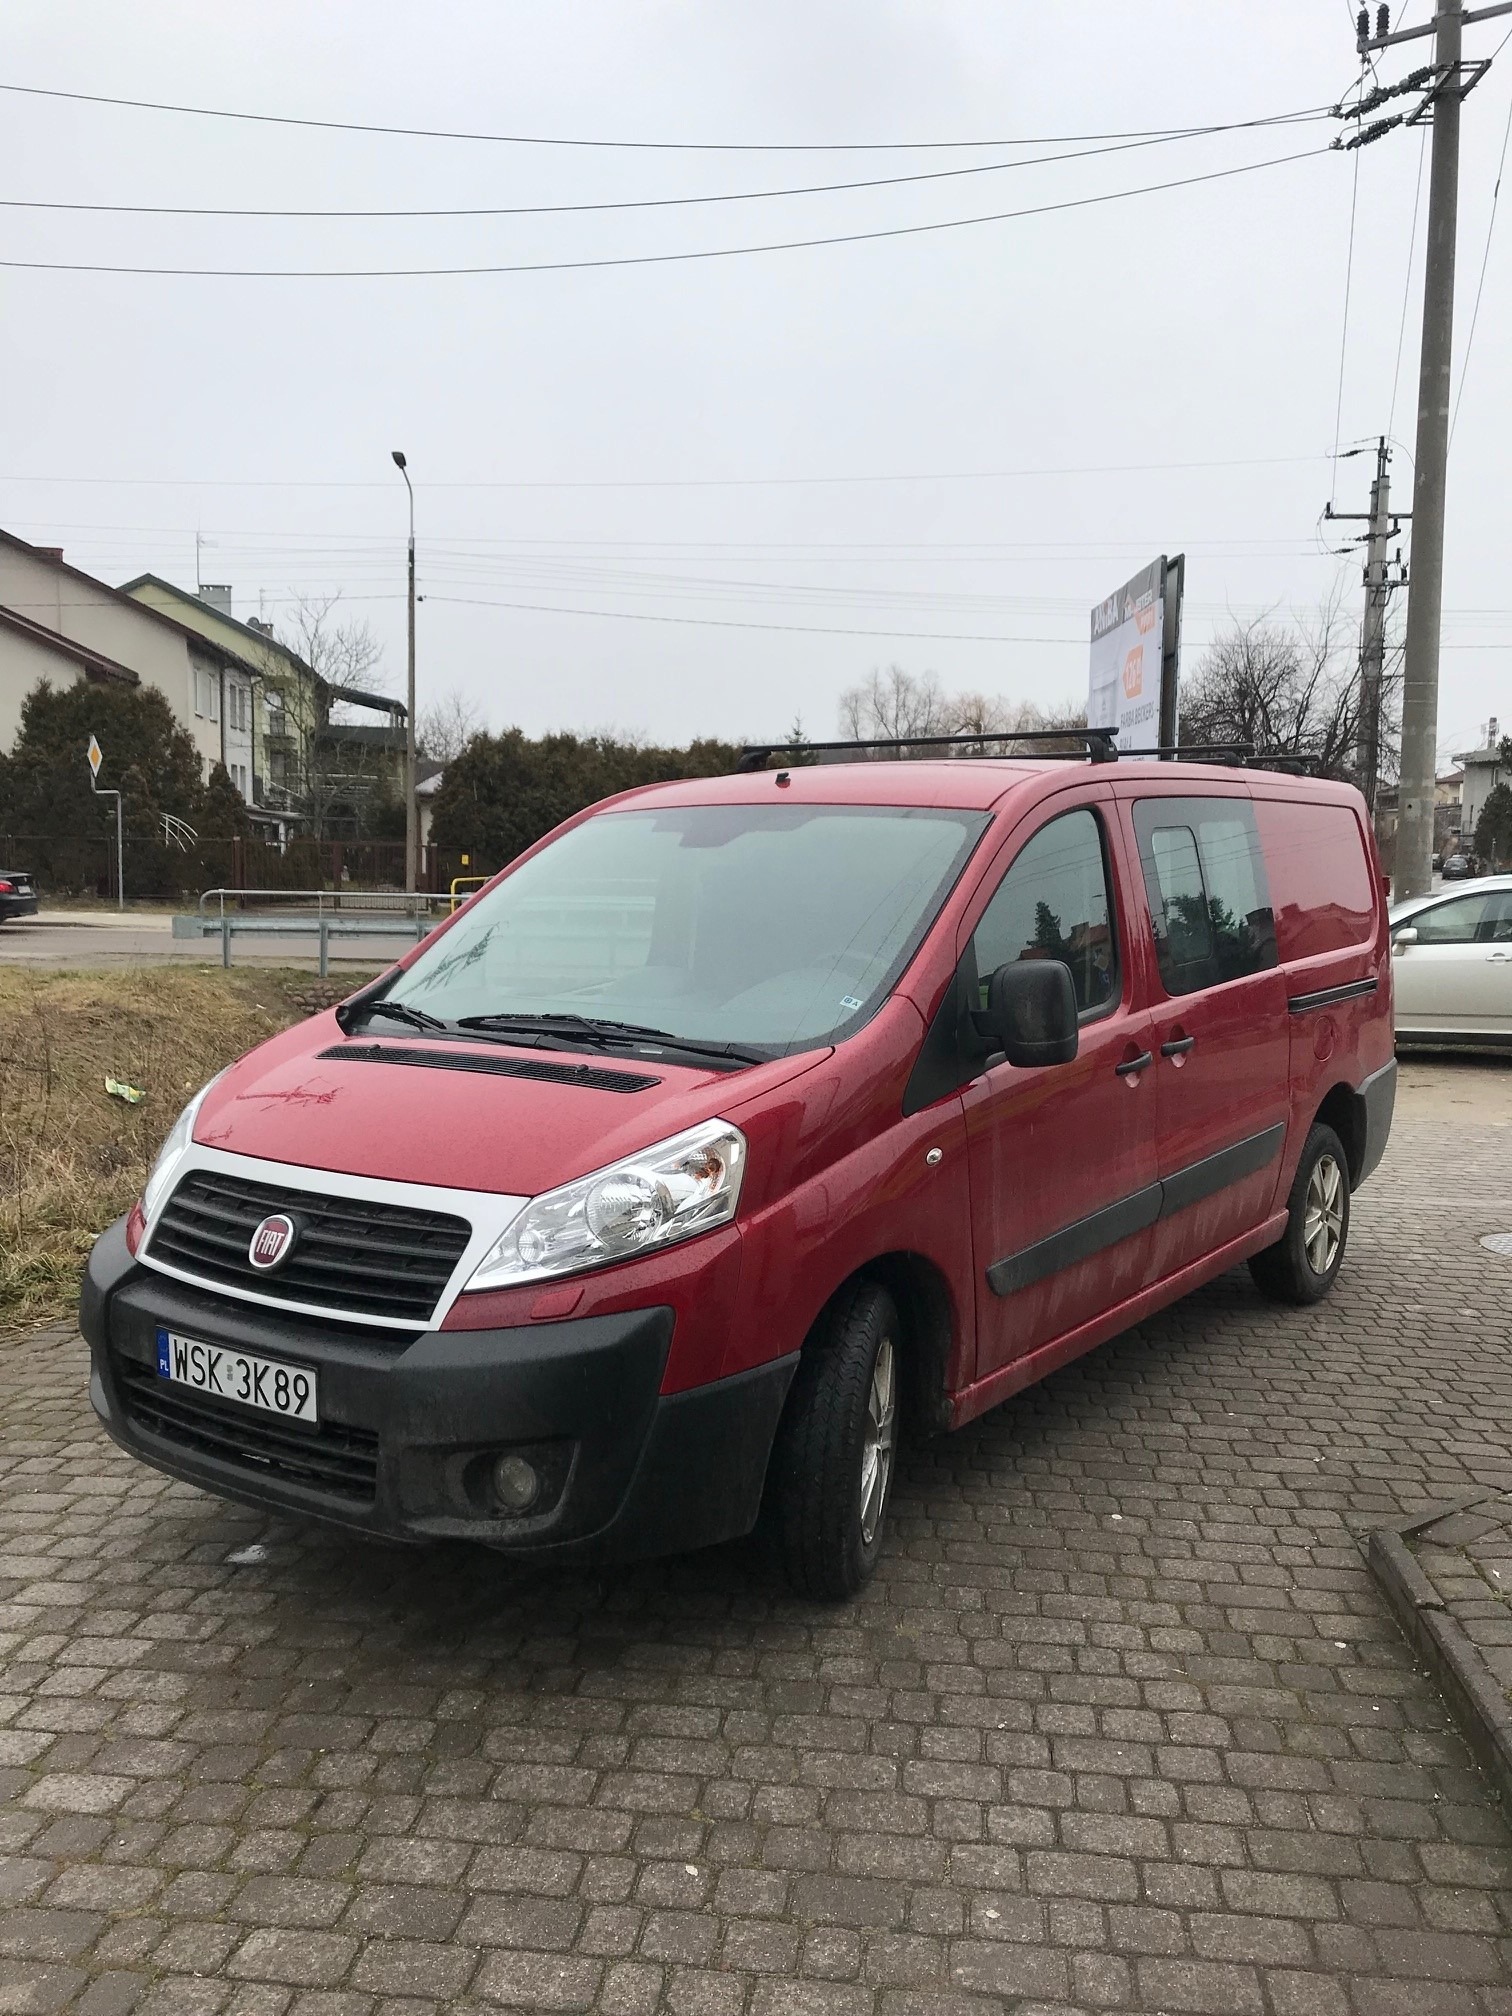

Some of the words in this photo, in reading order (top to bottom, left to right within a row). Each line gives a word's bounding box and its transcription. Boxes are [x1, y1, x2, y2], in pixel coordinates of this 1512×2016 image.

[256, 1230, 285, 1256] FIAT
[160, 1359, 169, 1371] PL
[174, 1339, 223, 1393] WSK
[236, 1358, 309, 1414] 3K89
